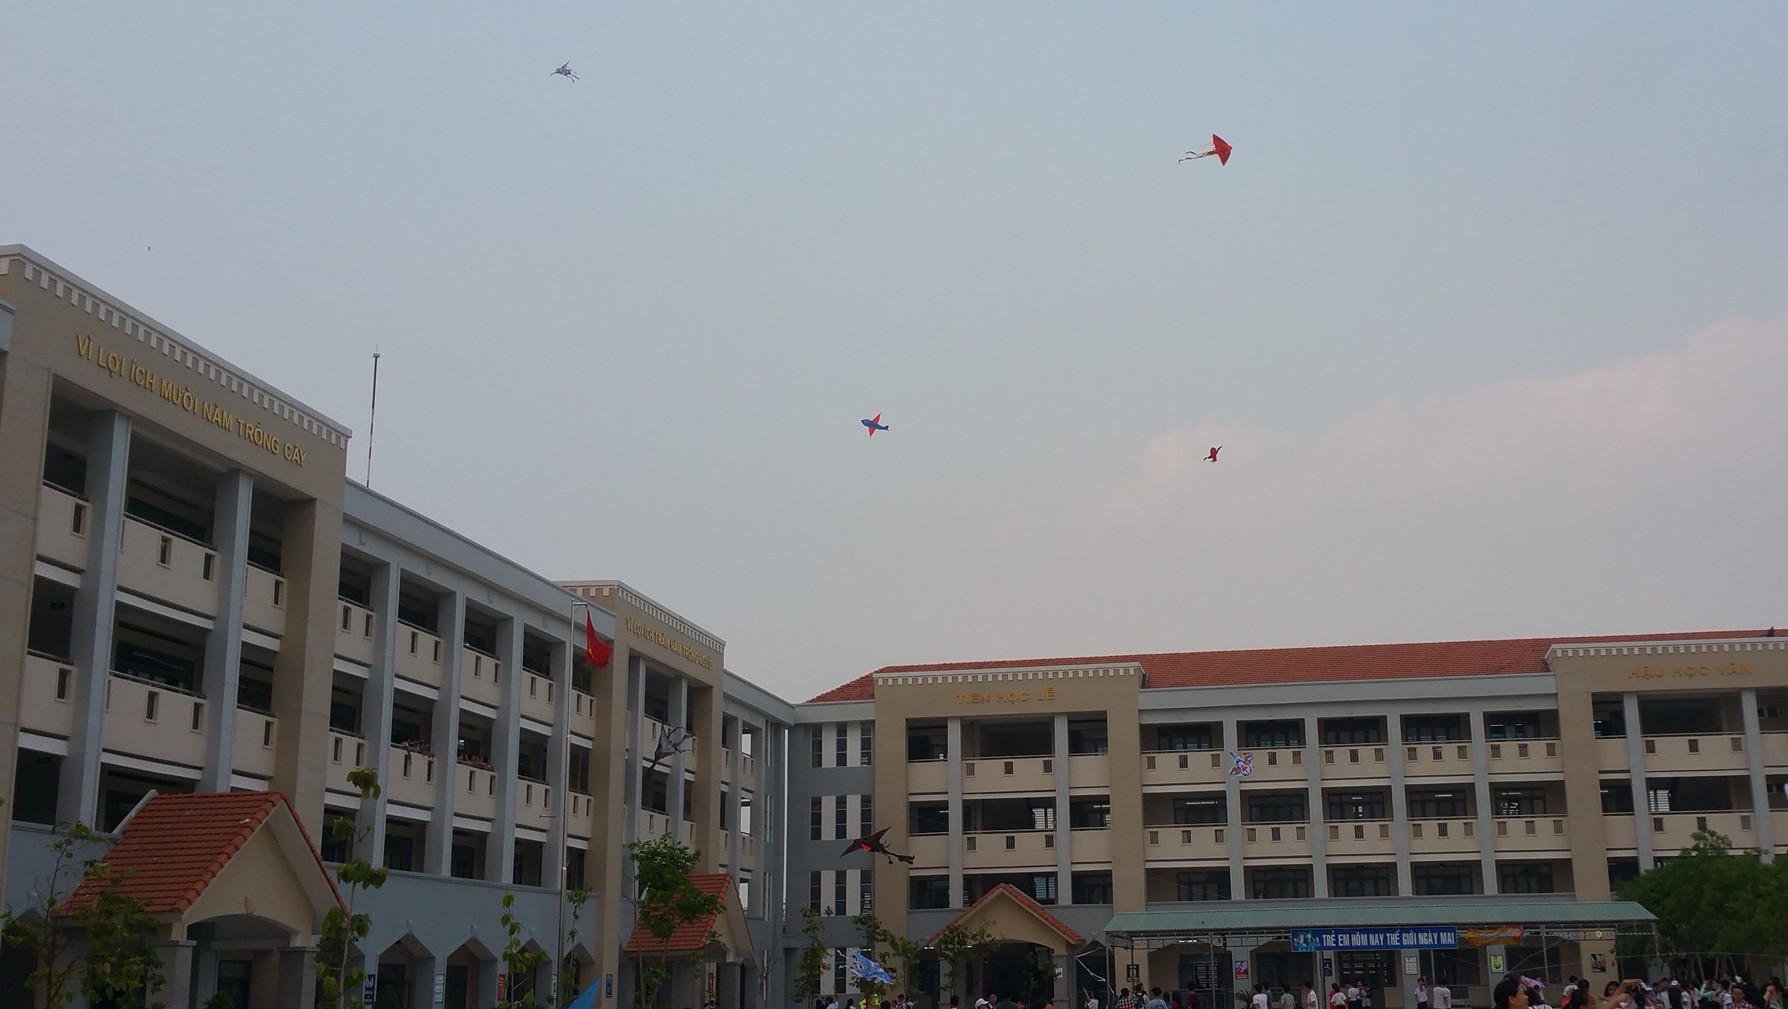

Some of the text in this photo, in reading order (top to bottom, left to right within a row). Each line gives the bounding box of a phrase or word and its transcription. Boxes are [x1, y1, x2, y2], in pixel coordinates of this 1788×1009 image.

[76, 334, 92, 360] VÌ
[97, 345, 124, 377] LỢI
[130, 358, 156, 392] ÍCH
[160, 378, 198, 414] MƯỜI
[283, 443, 307, 467] CÂY
[1322, 930, 1336, 947] TRẺ
[1338, 934, 1350, 947] EM
[1351, 932, 1368, 946] HÔM
[1369, 933, 1385, 946] NAY
[1386, 929, 1400, 946] THẾ
[1418, 930, 1438, 945] NGÀY
[1439, 932, 1455, 945] MAI
